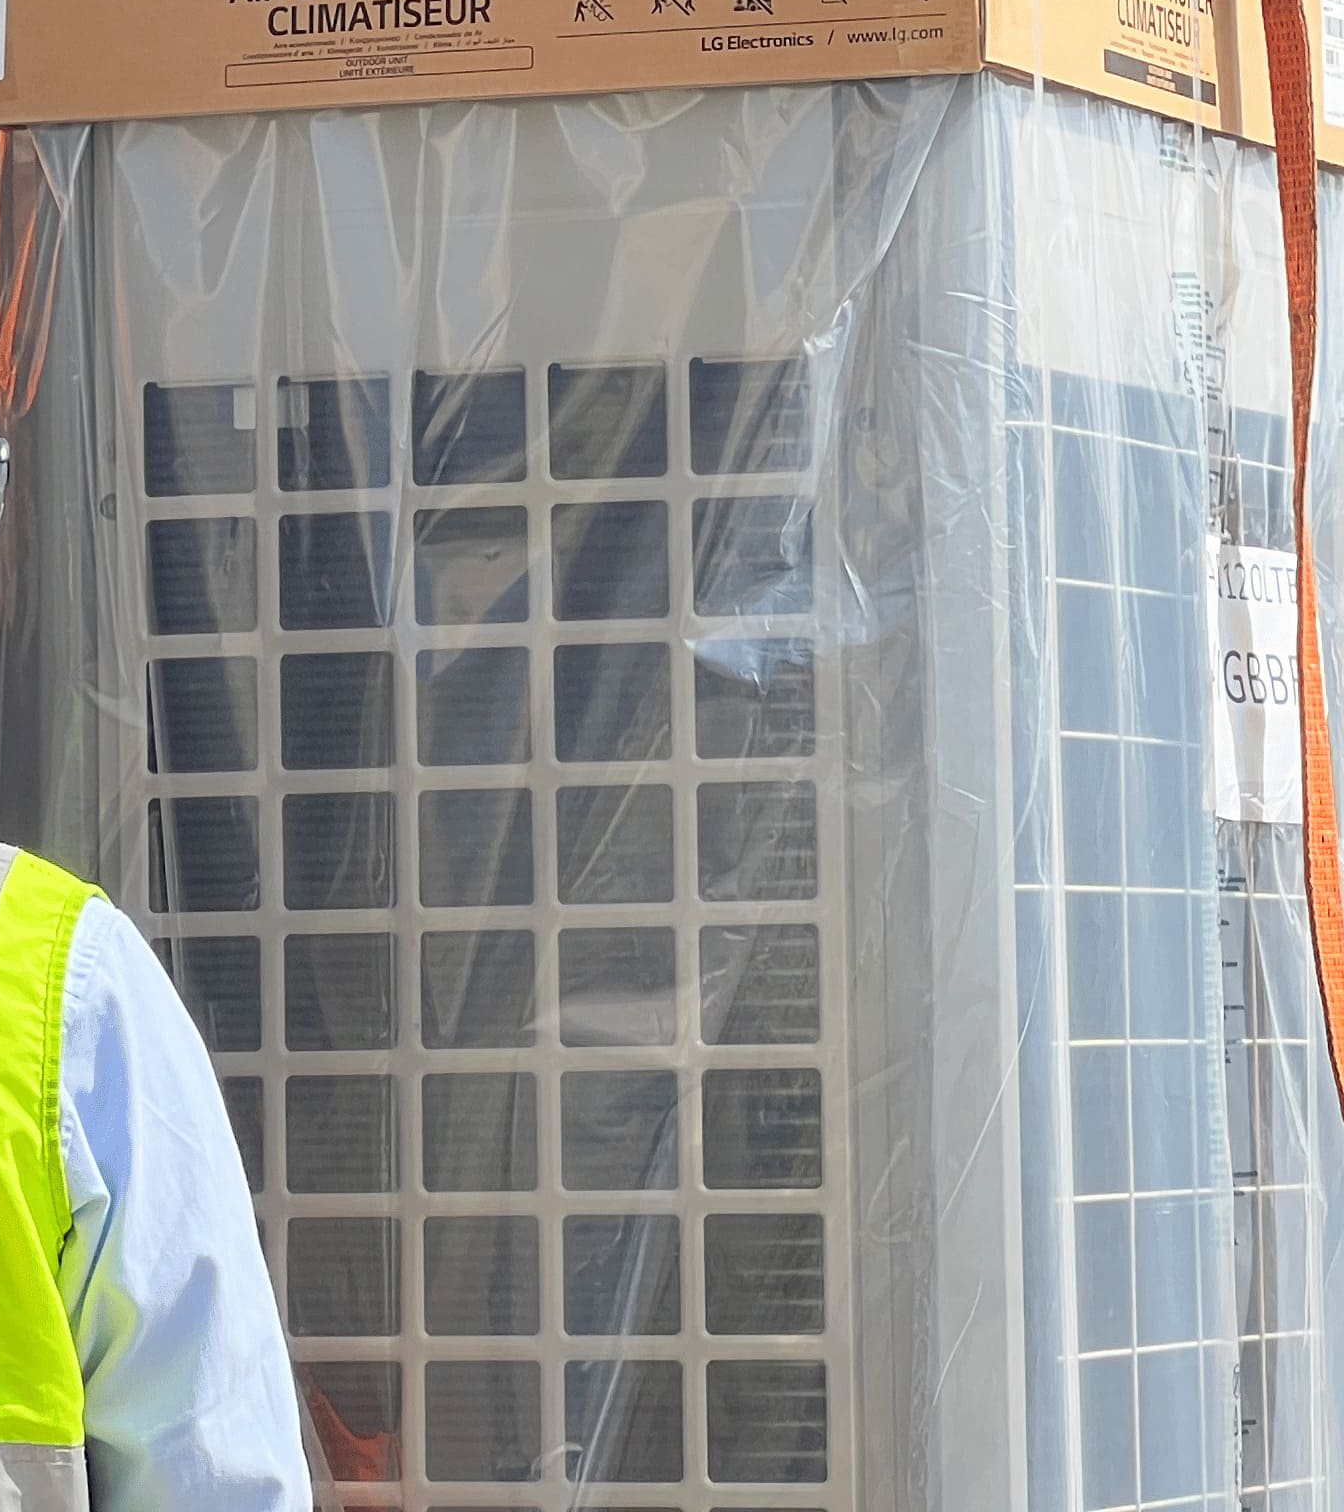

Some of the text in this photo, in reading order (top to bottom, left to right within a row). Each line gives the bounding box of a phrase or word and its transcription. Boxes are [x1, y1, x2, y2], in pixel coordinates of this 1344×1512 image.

[701, 36, 723, 52] LG
[727, 32, 814, 51] Electronics
[847, 27, 944, 45] www.lg.com
[345, 55, 408, 68] OUTDOOR UNIT
